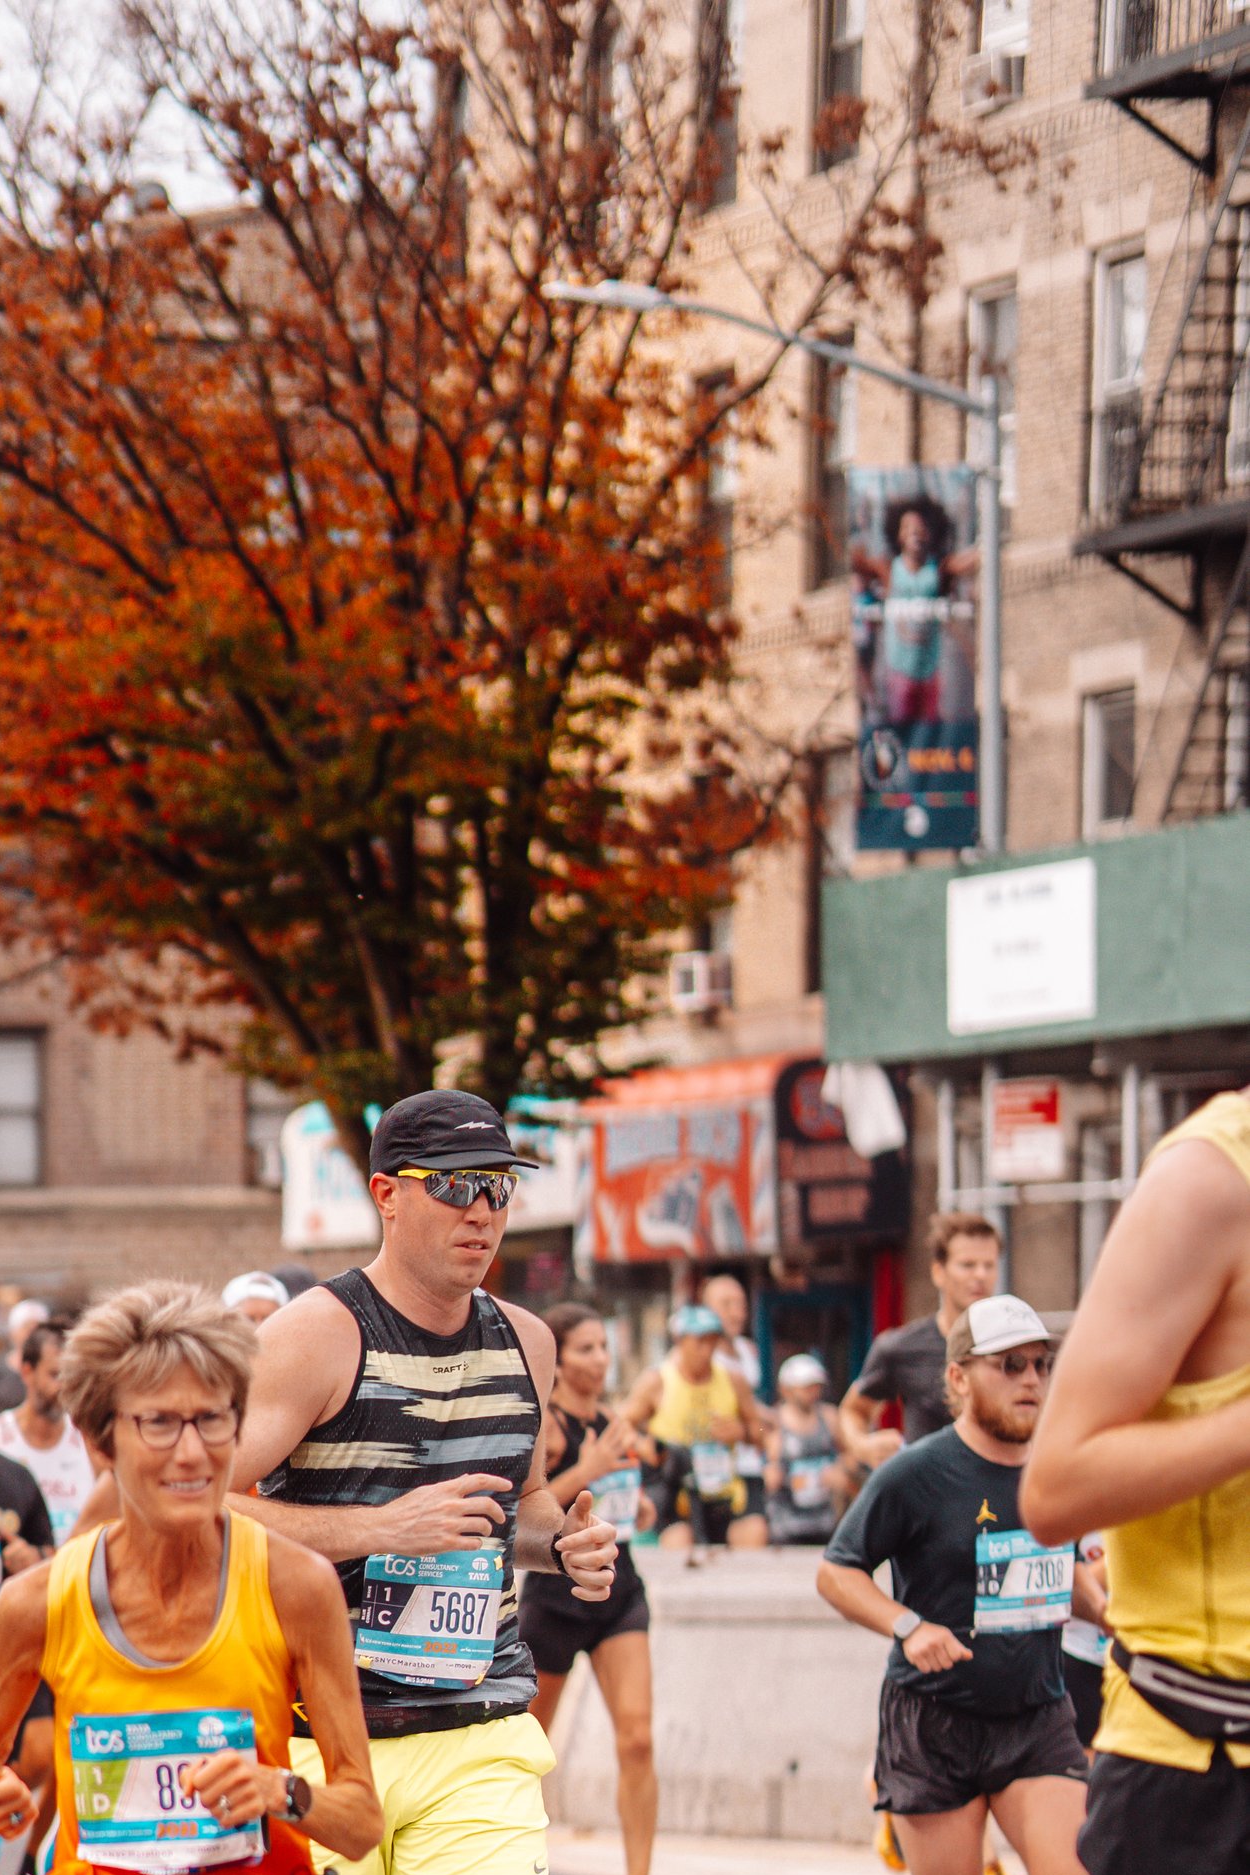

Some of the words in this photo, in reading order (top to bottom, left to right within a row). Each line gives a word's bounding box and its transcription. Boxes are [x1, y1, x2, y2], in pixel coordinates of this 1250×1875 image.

[384, 1554, 417, 1576] tcs
[420, 1556, 436, 1564] TATA
[418, 1570, 443, 1578] SERVICES
[419, 1564, 460, 1572] CONSULTANCY
[468, 1572, 490, 1581] TATA
[384, 1587, 392, 1602] 1
[378, 1610, 392, 1625] C
[430, 1590, 490, 1635] 5687
[423, 1641, 458, 1654] 2022
[85, 1724, 125, 1754] tcs
[92, 1766, 103, 1785] 1
[93, 1793, 111, 1814] D
